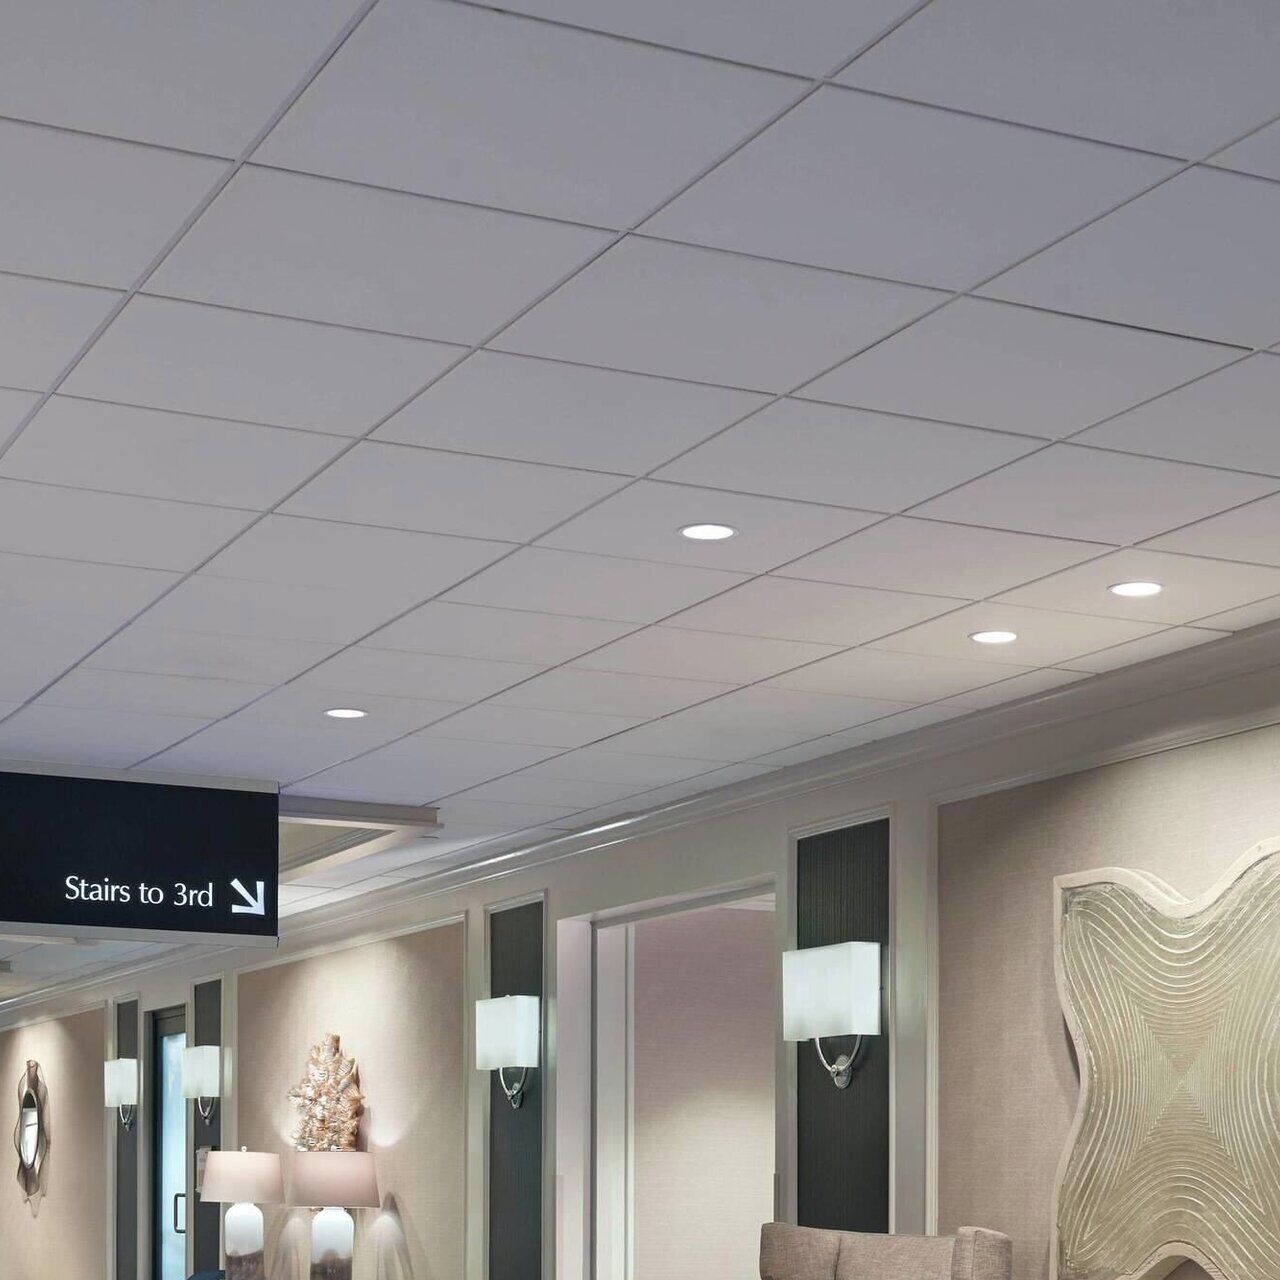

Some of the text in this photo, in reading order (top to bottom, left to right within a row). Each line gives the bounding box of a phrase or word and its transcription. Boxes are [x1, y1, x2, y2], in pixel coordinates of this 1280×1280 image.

[65, 876, 213, 907] Stairs to 3rd
